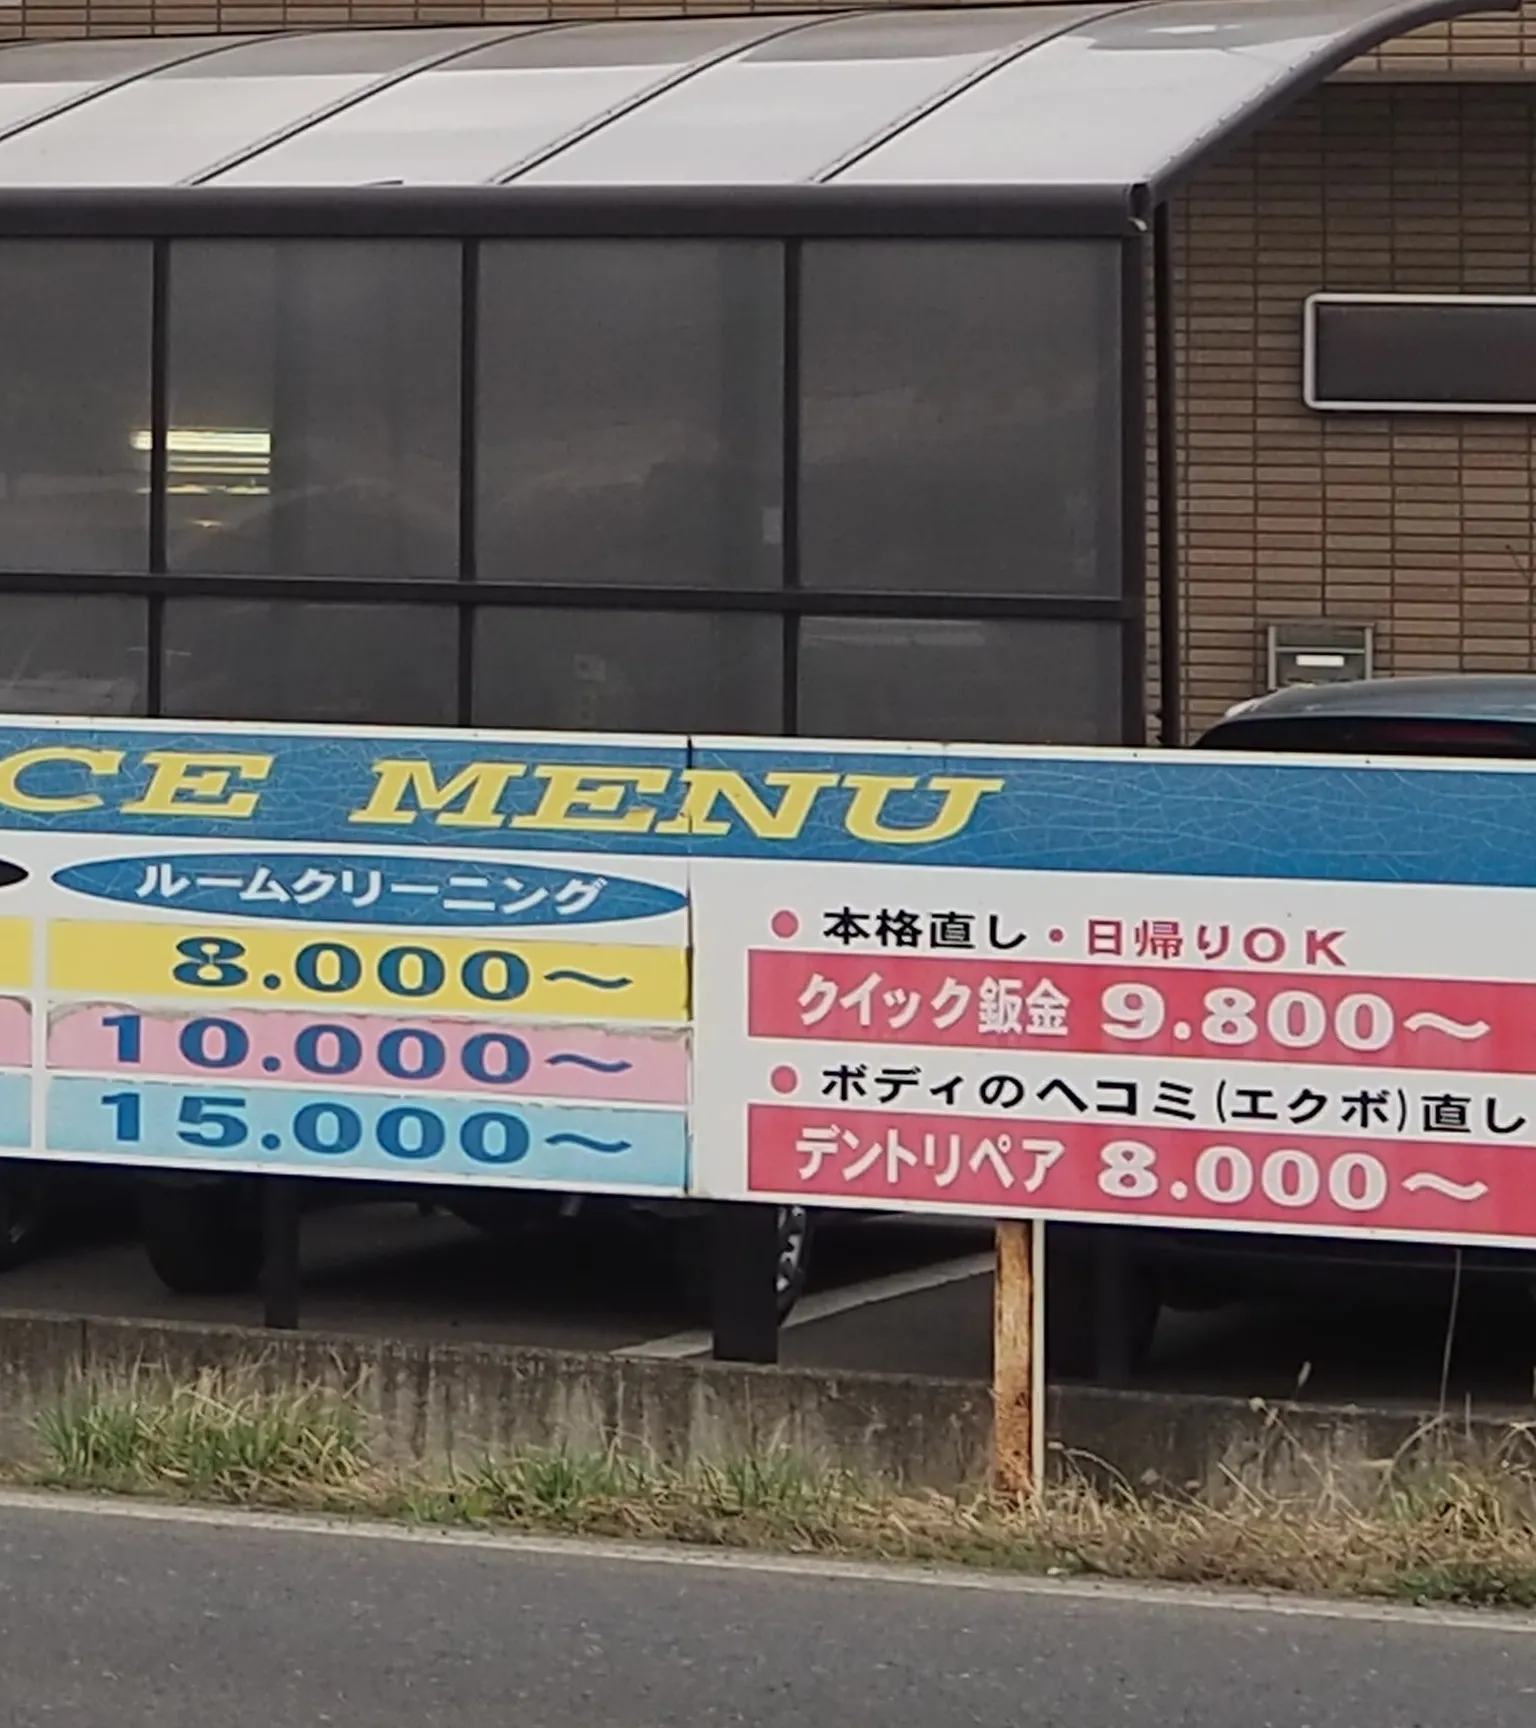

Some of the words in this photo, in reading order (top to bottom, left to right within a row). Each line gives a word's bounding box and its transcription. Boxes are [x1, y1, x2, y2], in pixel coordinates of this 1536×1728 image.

[348, 759, 1005, 843] MENU
[136, 863, 606, 916] ルームクリーニング
[797, 973, 1070, 1037] クイック鈑金
[795, 1125, 1065, 1192] デントリペア
